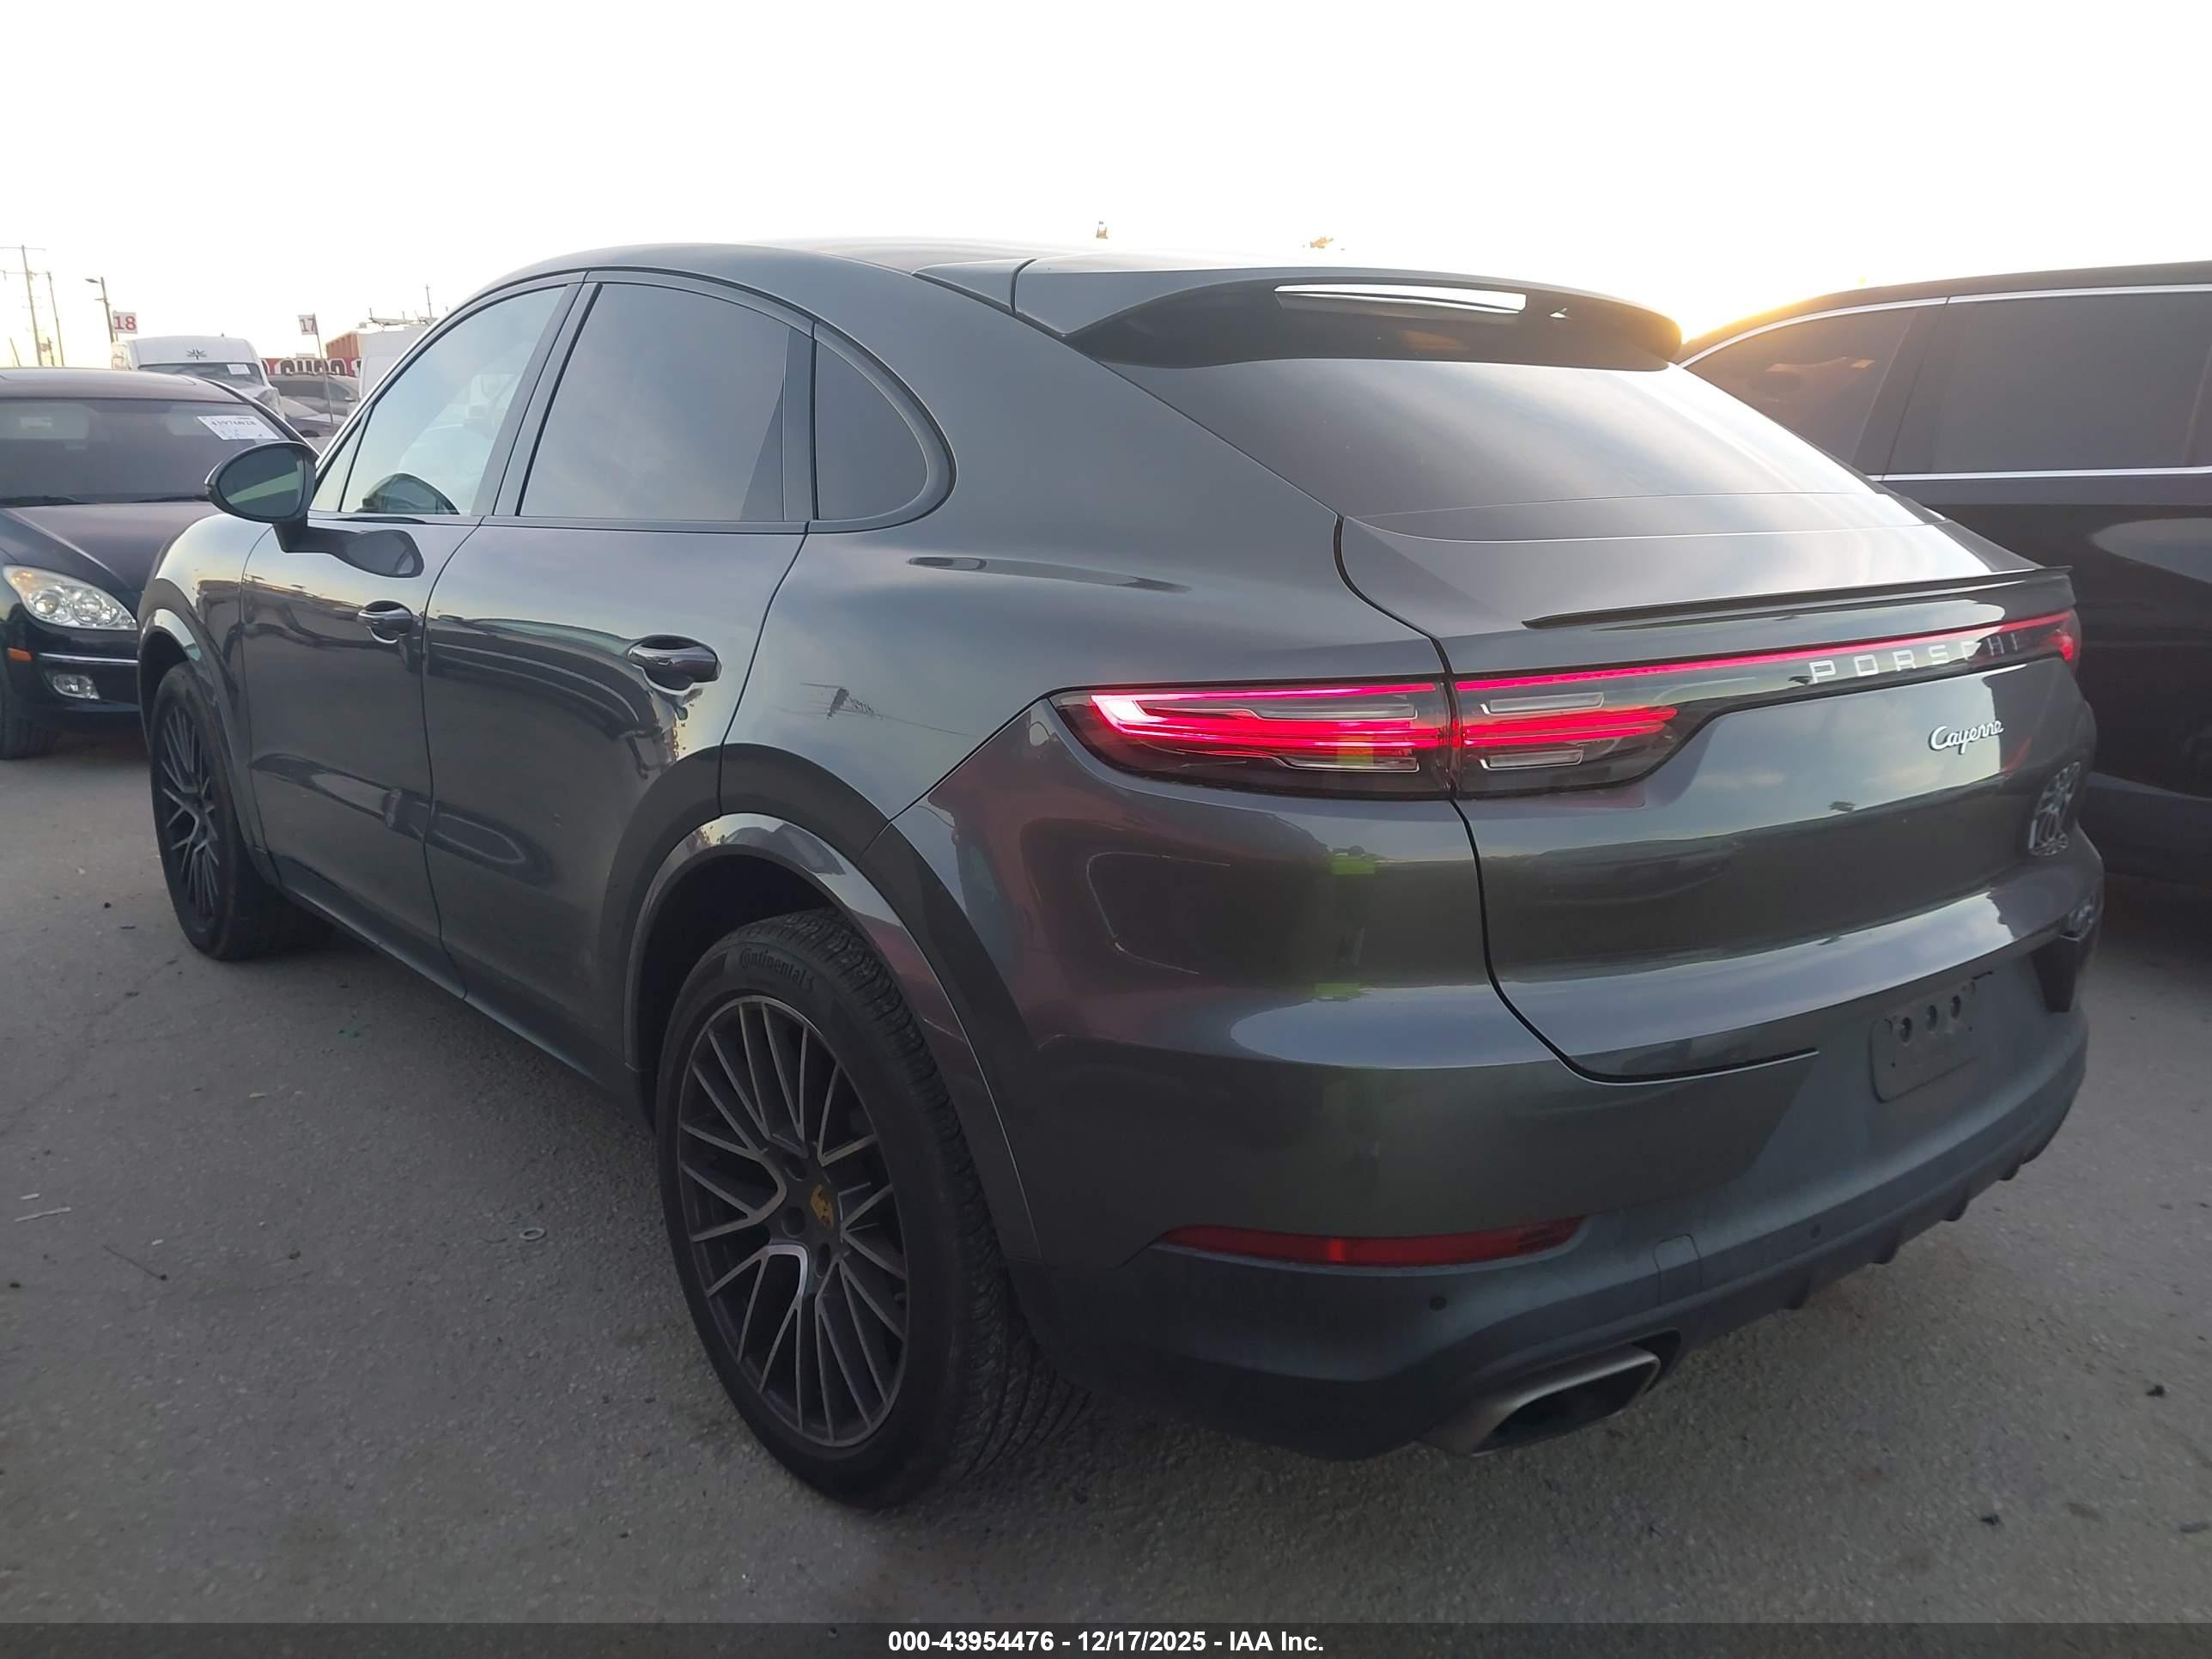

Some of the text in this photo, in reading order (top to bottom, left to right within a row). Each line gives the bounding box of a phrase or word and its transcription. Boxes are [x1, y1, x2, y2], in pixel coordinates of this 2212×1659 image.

[113, 315, 137, 331] 18
[300, 318, 315, 332] 17
[1929, 720, 2004, 754] Cayenne
[740, 947, 807, 990] Continental
